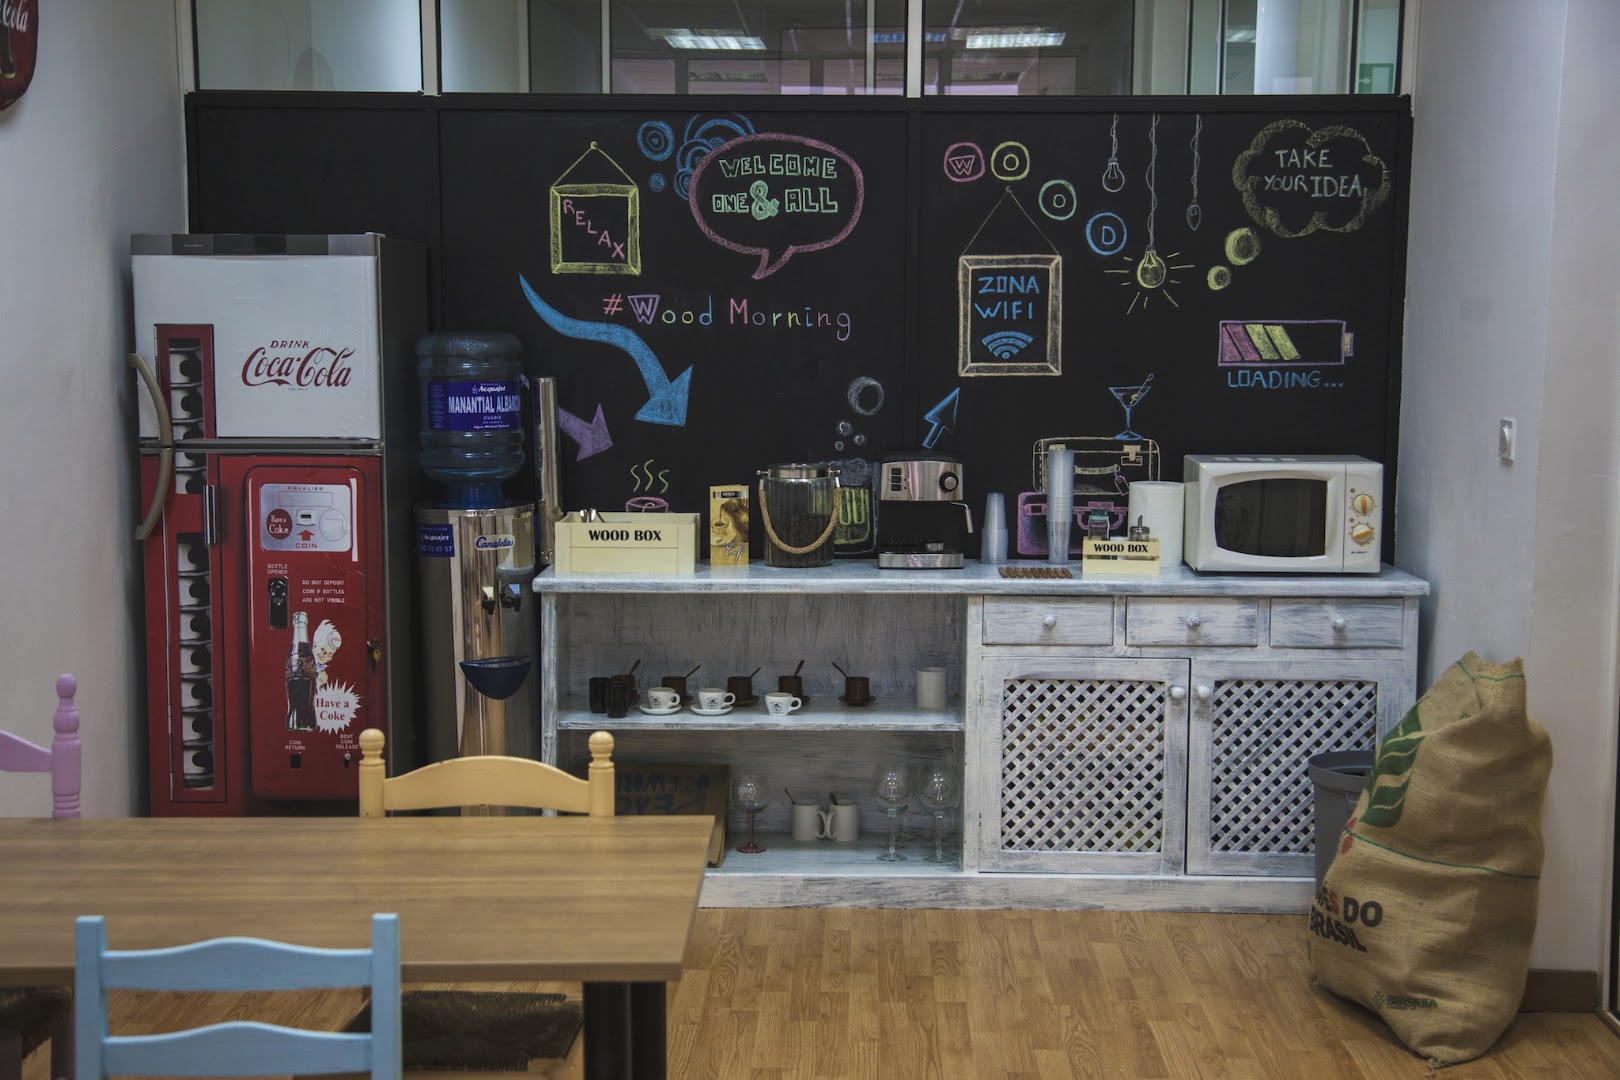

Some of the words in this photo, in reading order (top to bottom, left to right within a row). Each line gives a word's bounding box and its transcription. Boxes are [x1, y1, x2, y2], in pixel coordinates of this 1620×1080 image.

[719, 154, 838, 179] WELCOME
[1274, 148, 1333, 169] TAKE
[1264, 174, 1309, 192] YOUR
[1309, 173, 1362, 198] IDEA
[712, 193, 750, 213] ONE
[749, 180, 780, 221] &
[784, 187, 838, 213] ALL
[562, 199, 626, 260] RELAX
[978, 275, 1040, 295] ZONA
[729, 297, 851, 342] Morning
[974, 301, 1033, 320] WIFI
[269, 340, 311, 349] DRINK
[241, 346, 357, 388] Coca-Cola
[1227, 369, 1344, 390] LOADING...
[448, 396, 495, 414] MANANTIAL
[270, 514, 283, 523] Have
[268, 524, 289, 534] Coke
[588, 529, 630, 542] WOOD
[634, 529, 662, 542] BOX
[444, 545, 453, 553] 57
[1094, 543, 1125, 553] WOOD
[1127, 544, 1149, 554] BOX
[316, 698, 341, 708] Have
[319, 710, 345, 721] Coke
[1343, 896, 1383, 928] DO
[1309, 904, 1368, 953] BRASIL
